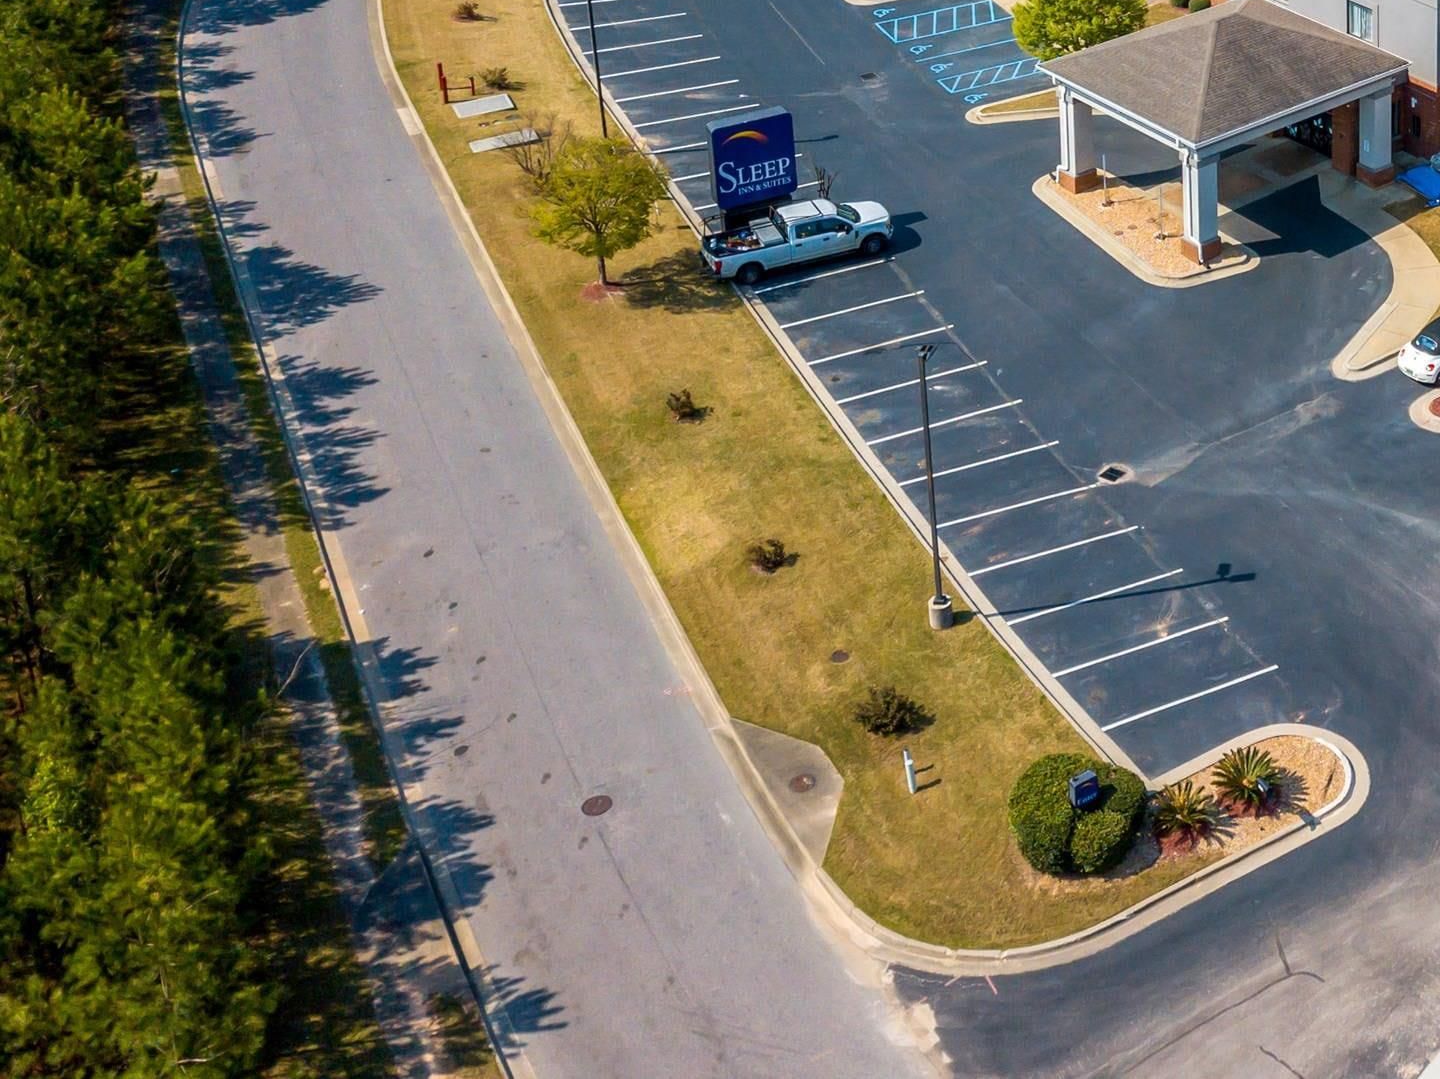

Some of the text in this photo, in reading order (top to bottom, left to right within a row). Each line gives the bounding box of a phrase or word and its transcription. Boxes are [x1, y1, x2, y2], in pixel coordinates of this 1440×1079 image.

[718, 157, 790, 193] SLEEP
[738, 185, 754, 195] INN
[763, 176, 791, 189] SUITES
